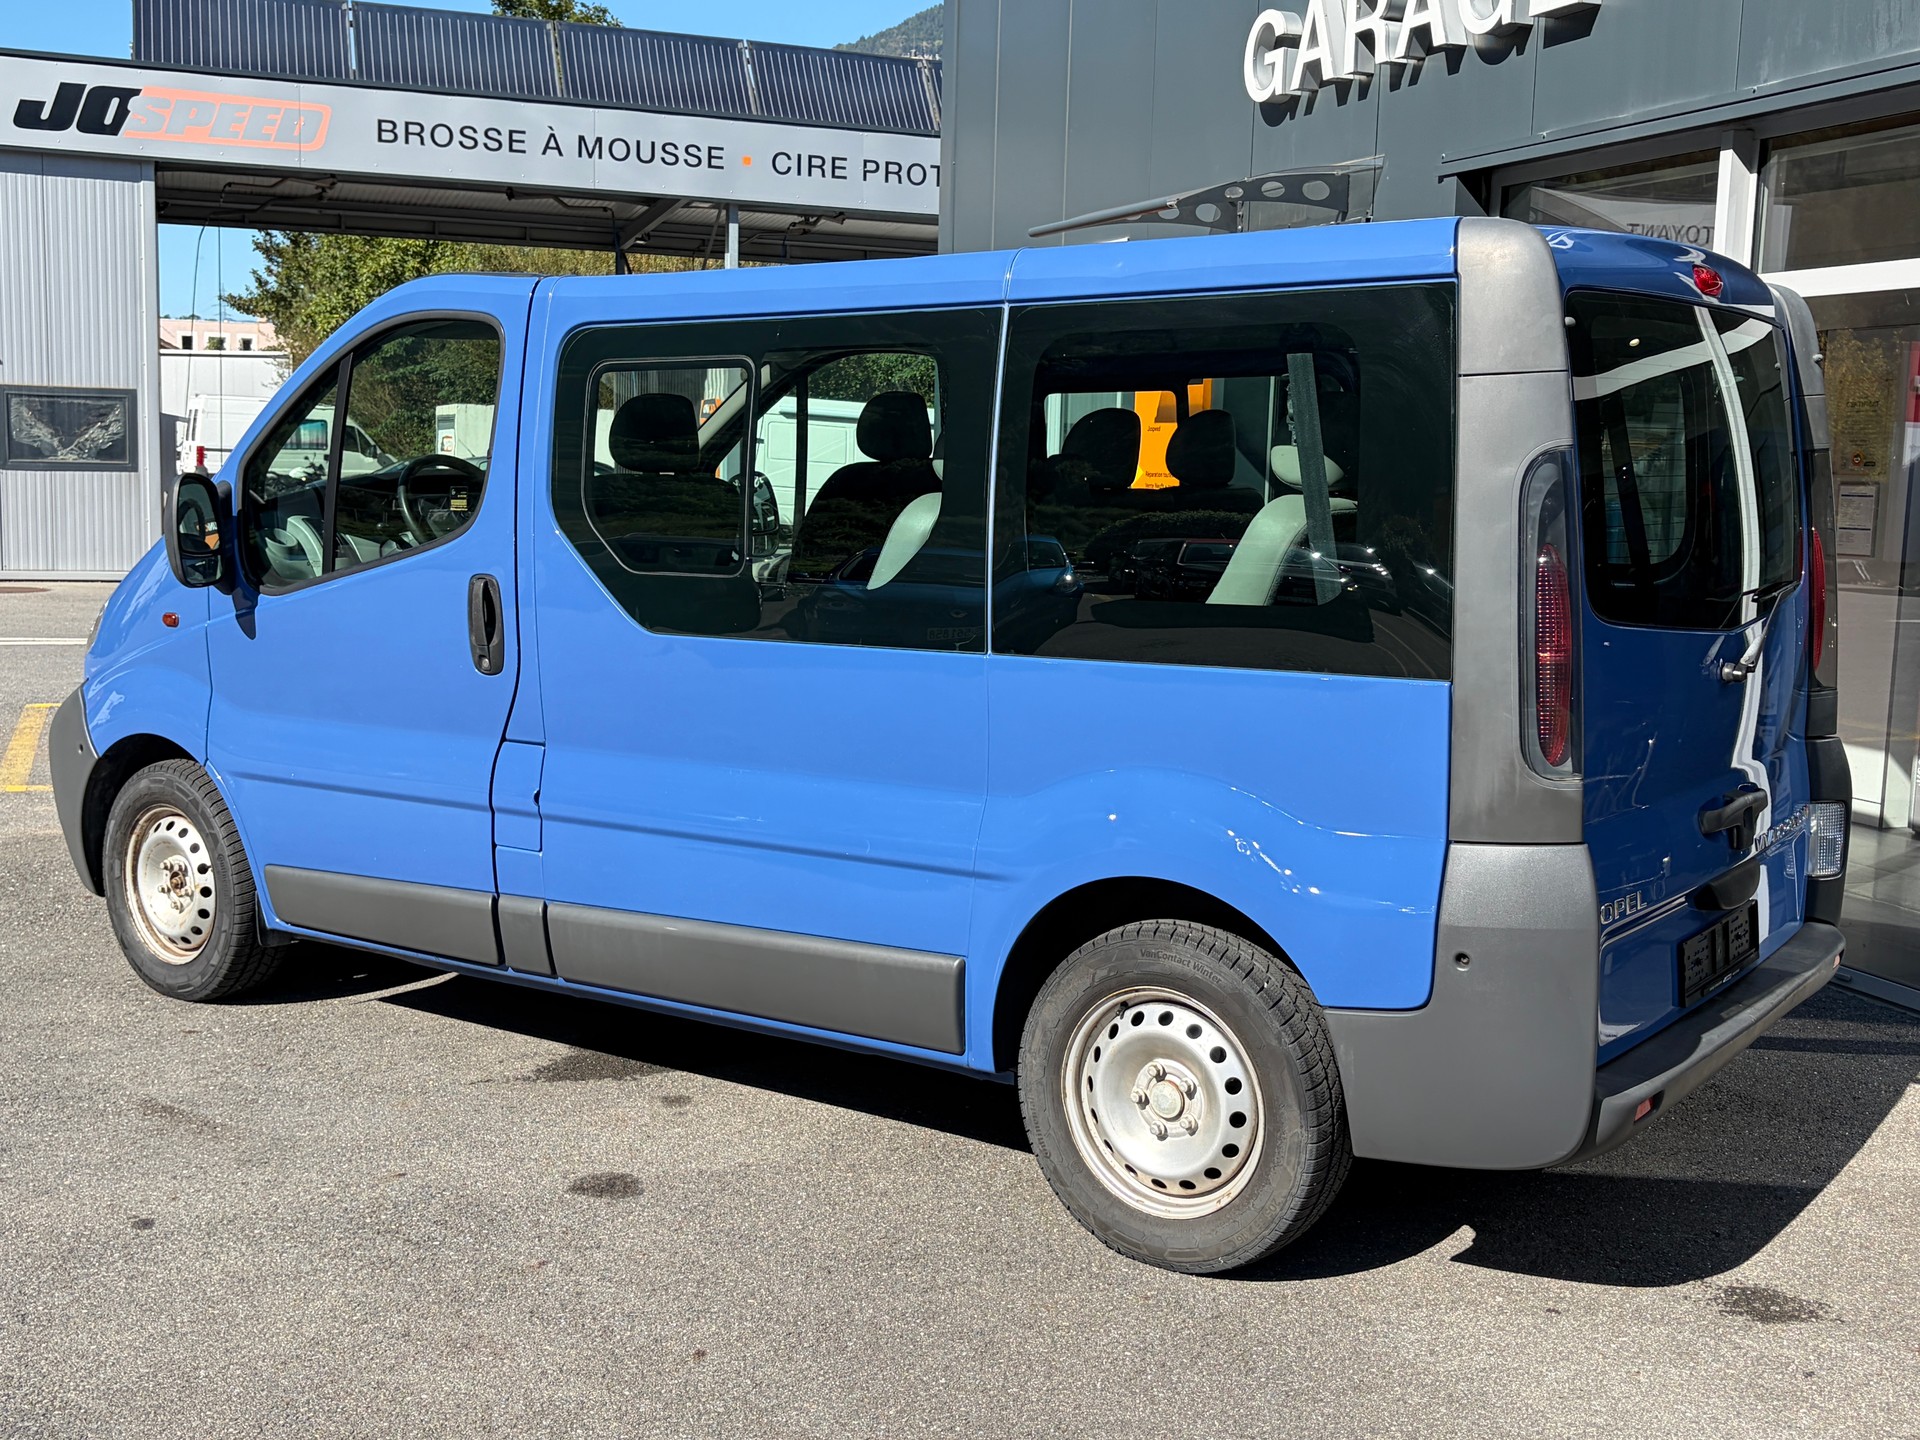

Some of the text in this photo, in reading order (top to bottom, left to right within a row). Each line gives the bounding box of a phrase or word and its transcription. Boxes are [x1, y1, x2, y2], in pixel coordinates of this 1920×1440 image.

[1243, 0, 1602, 103] GARA
[377, 119, 940, 187] BROSSE À MOUSSE CIRE PROT
[1601, 890, 1648, 925] OPEL
[1140, 948, 1222, 984] VanContact Winter
